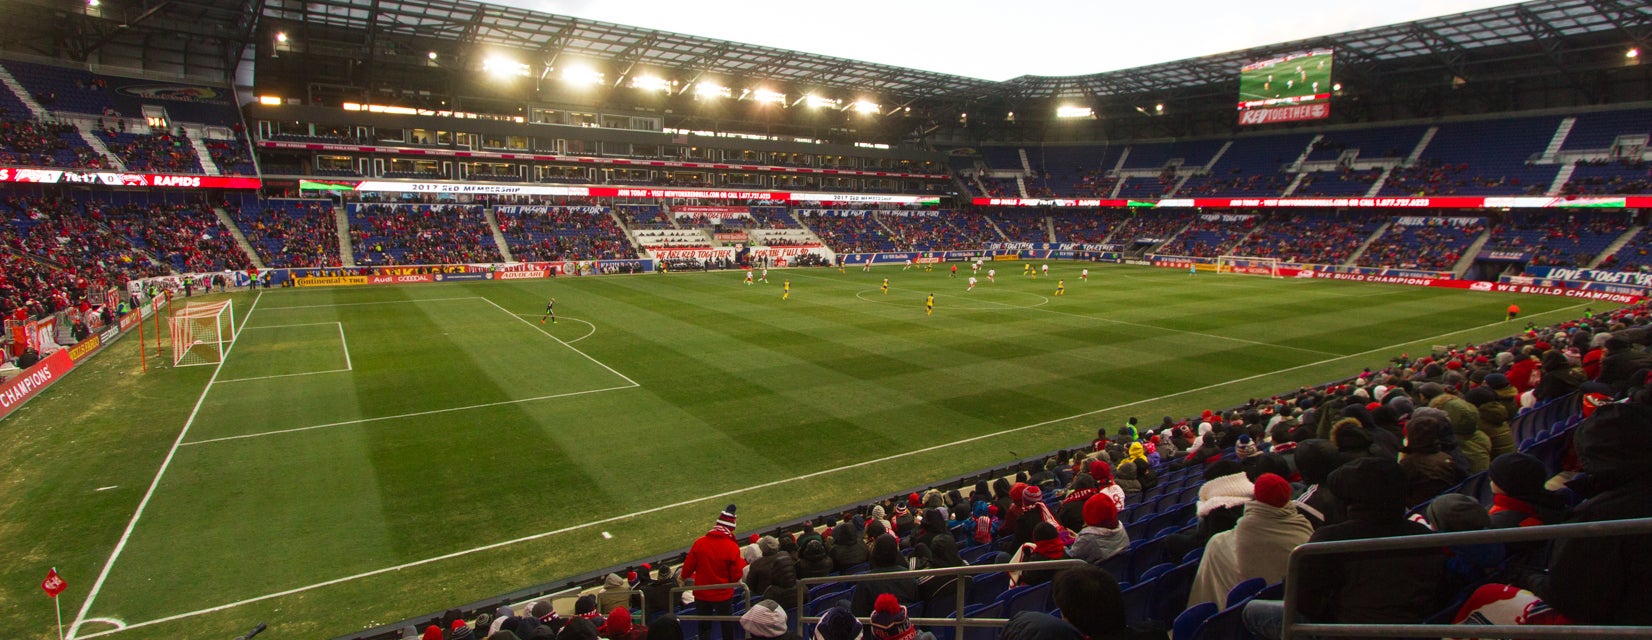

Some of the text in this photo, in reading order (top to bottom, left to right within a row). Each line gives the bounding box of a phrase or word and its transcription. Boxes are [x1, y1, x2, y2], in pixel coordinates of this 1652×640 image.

[153, 176, 201, 187] RAPIDS
[617, 189, 630, 197] JOIN
[681, 250, 696, 259] RED
[698, 249, 732, 259] TOGETHER
[1317, 271, 1432, 286] WE BUILD CHAMPIONS
[1546, 267, 1582, 281] LOVE
[297, 277, 341, 286] Continental
[373, 276, 393, 284] Audi
[1497, 284, 1632, 304] WE BUILD CHAMPIONS
